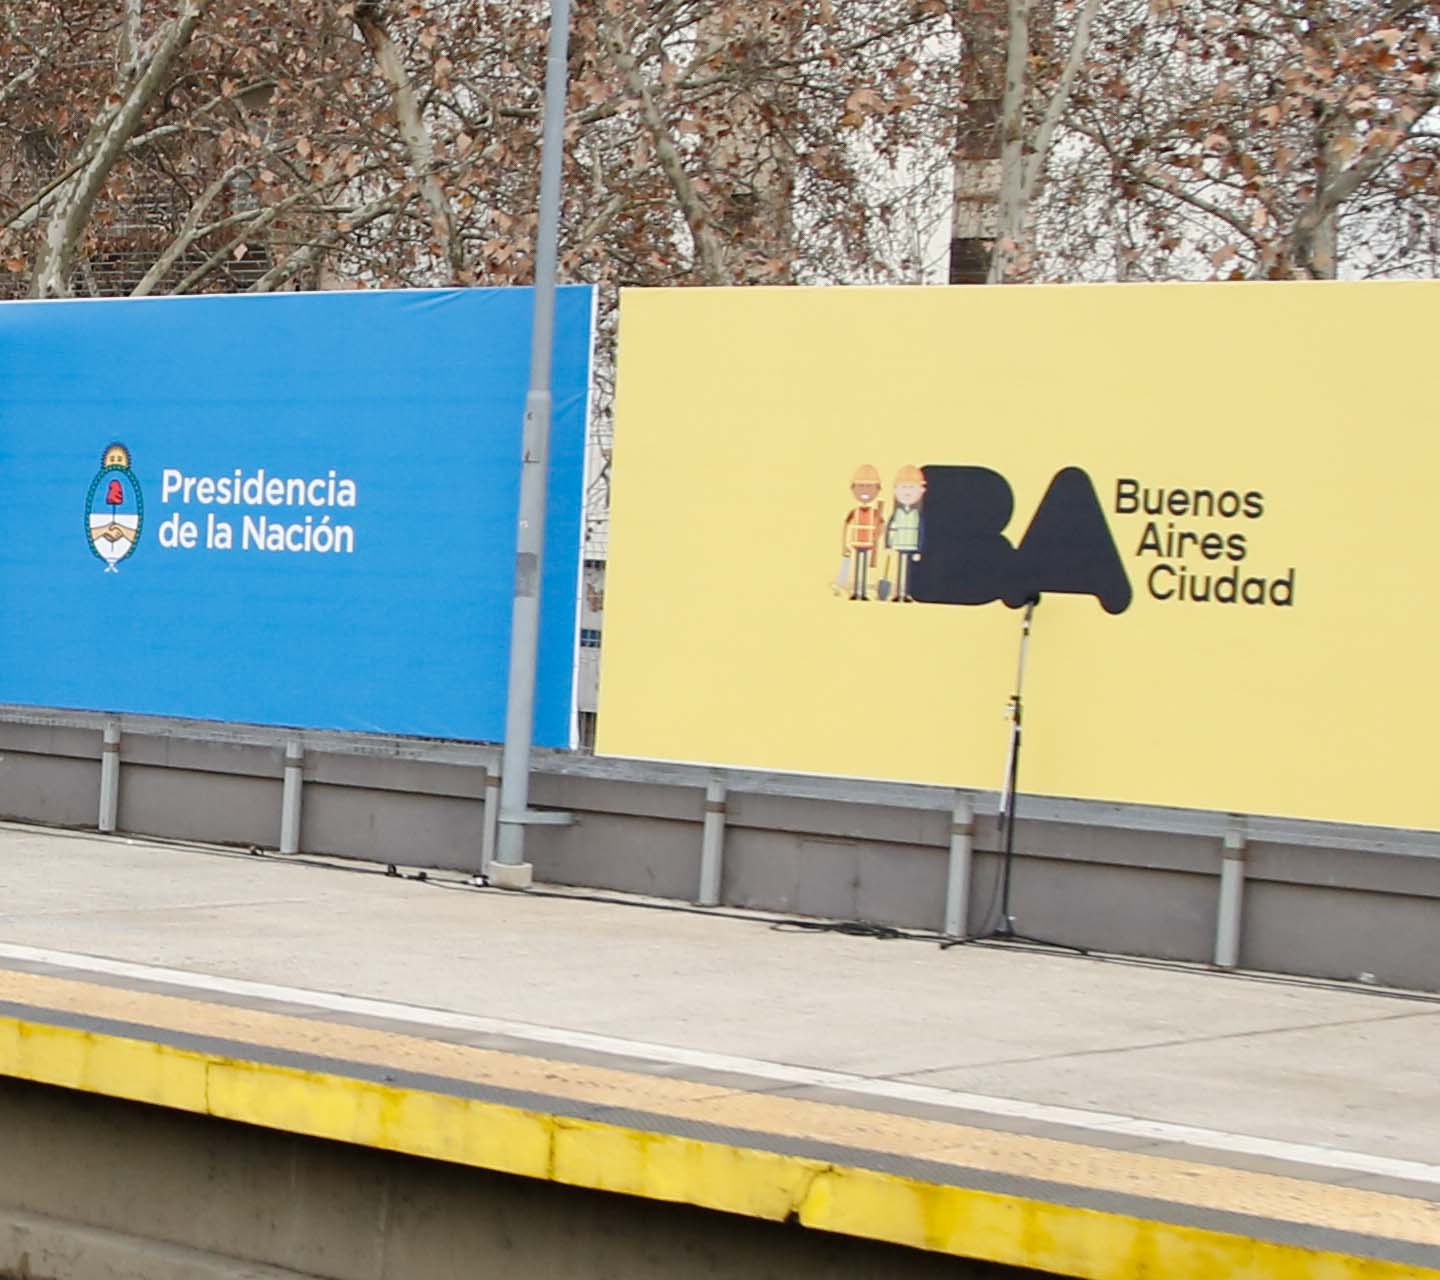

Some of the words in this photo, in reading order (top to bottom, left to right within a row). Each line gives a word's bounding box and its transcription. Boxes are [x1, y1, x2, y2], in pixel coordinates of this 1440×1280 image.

[161, 468, 357, 507] Presidencia
[1114, 478, 1265, 519] Buenos
[158, 512, 199, 548] de
[206, 513, 233, 550] la
[241, 515, 355, 553] Nación
[910, 464, 1133, 615] BA
[1135, 522, 1247, 561] Aires
[1147, 563, 1296, 607] Ciudad
